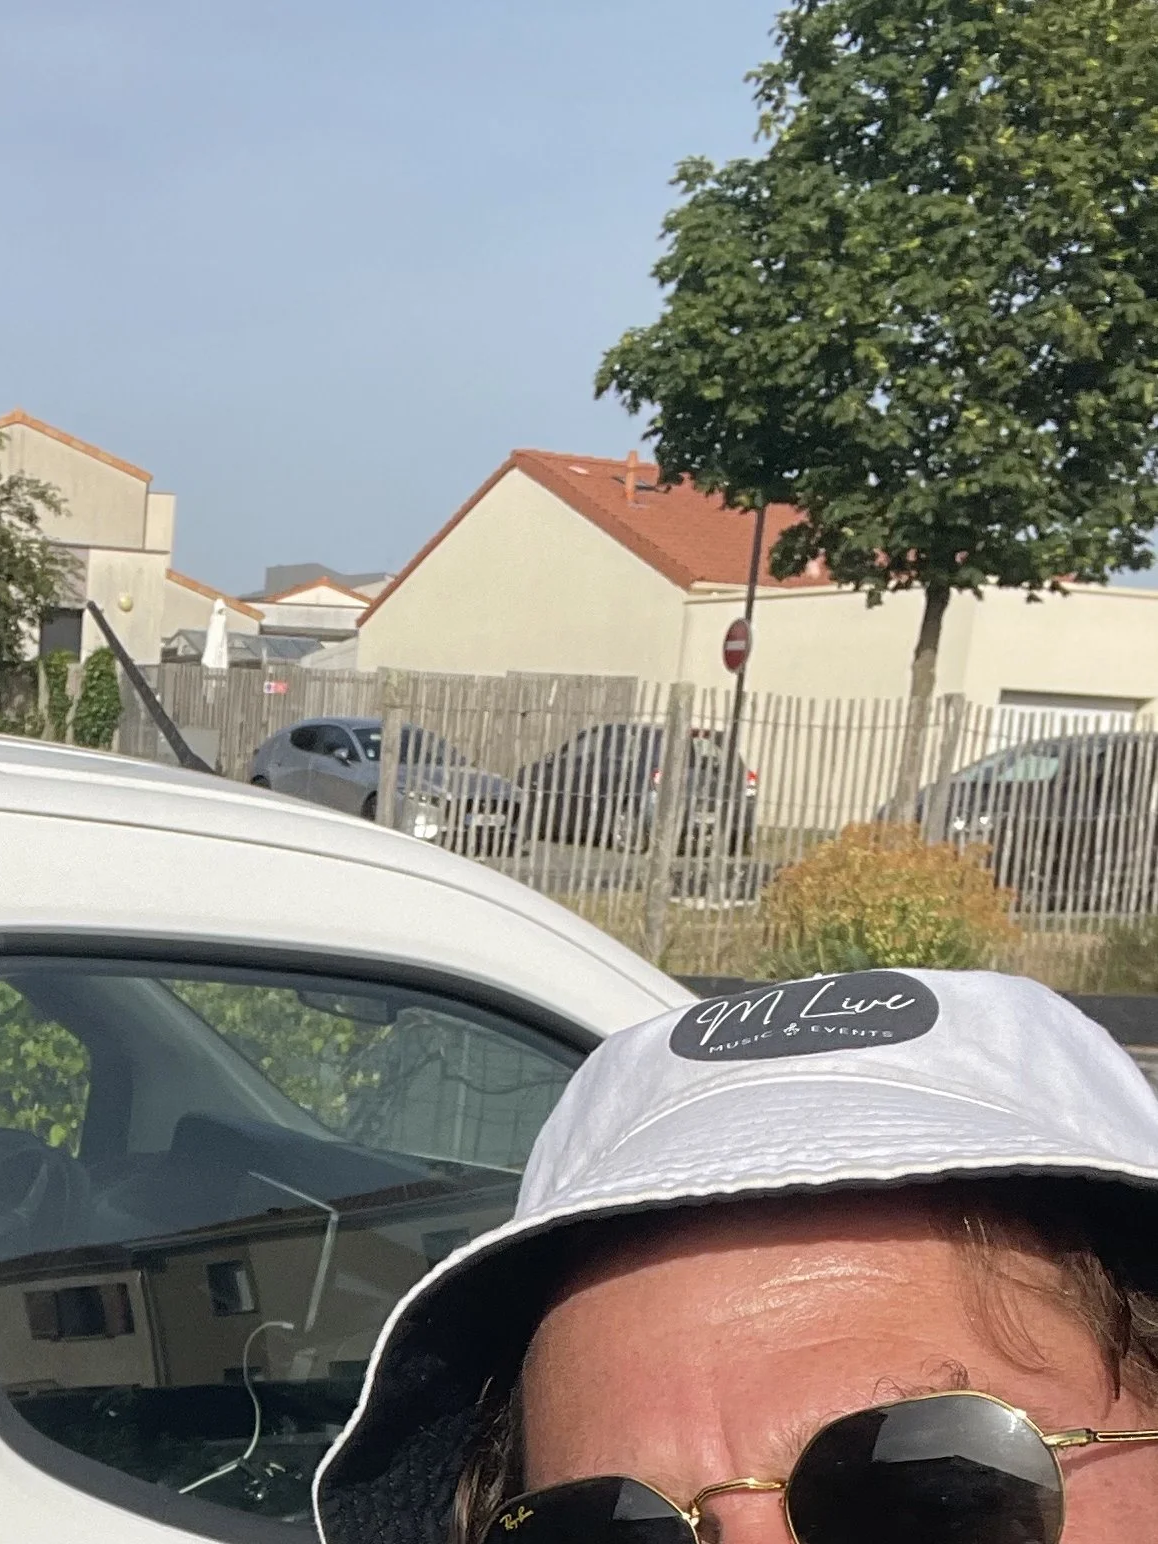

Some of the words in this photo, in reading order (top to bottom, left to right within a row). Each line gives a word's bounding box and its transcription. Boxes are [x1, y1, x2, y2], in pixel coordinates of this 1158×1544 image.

[696, 989, 785, 1047] M
[799, 980, 917, 1018] Live
[708, 1029, 774, 1054] MUSIC
[809, 1024, 894, 1038] EVENTS
